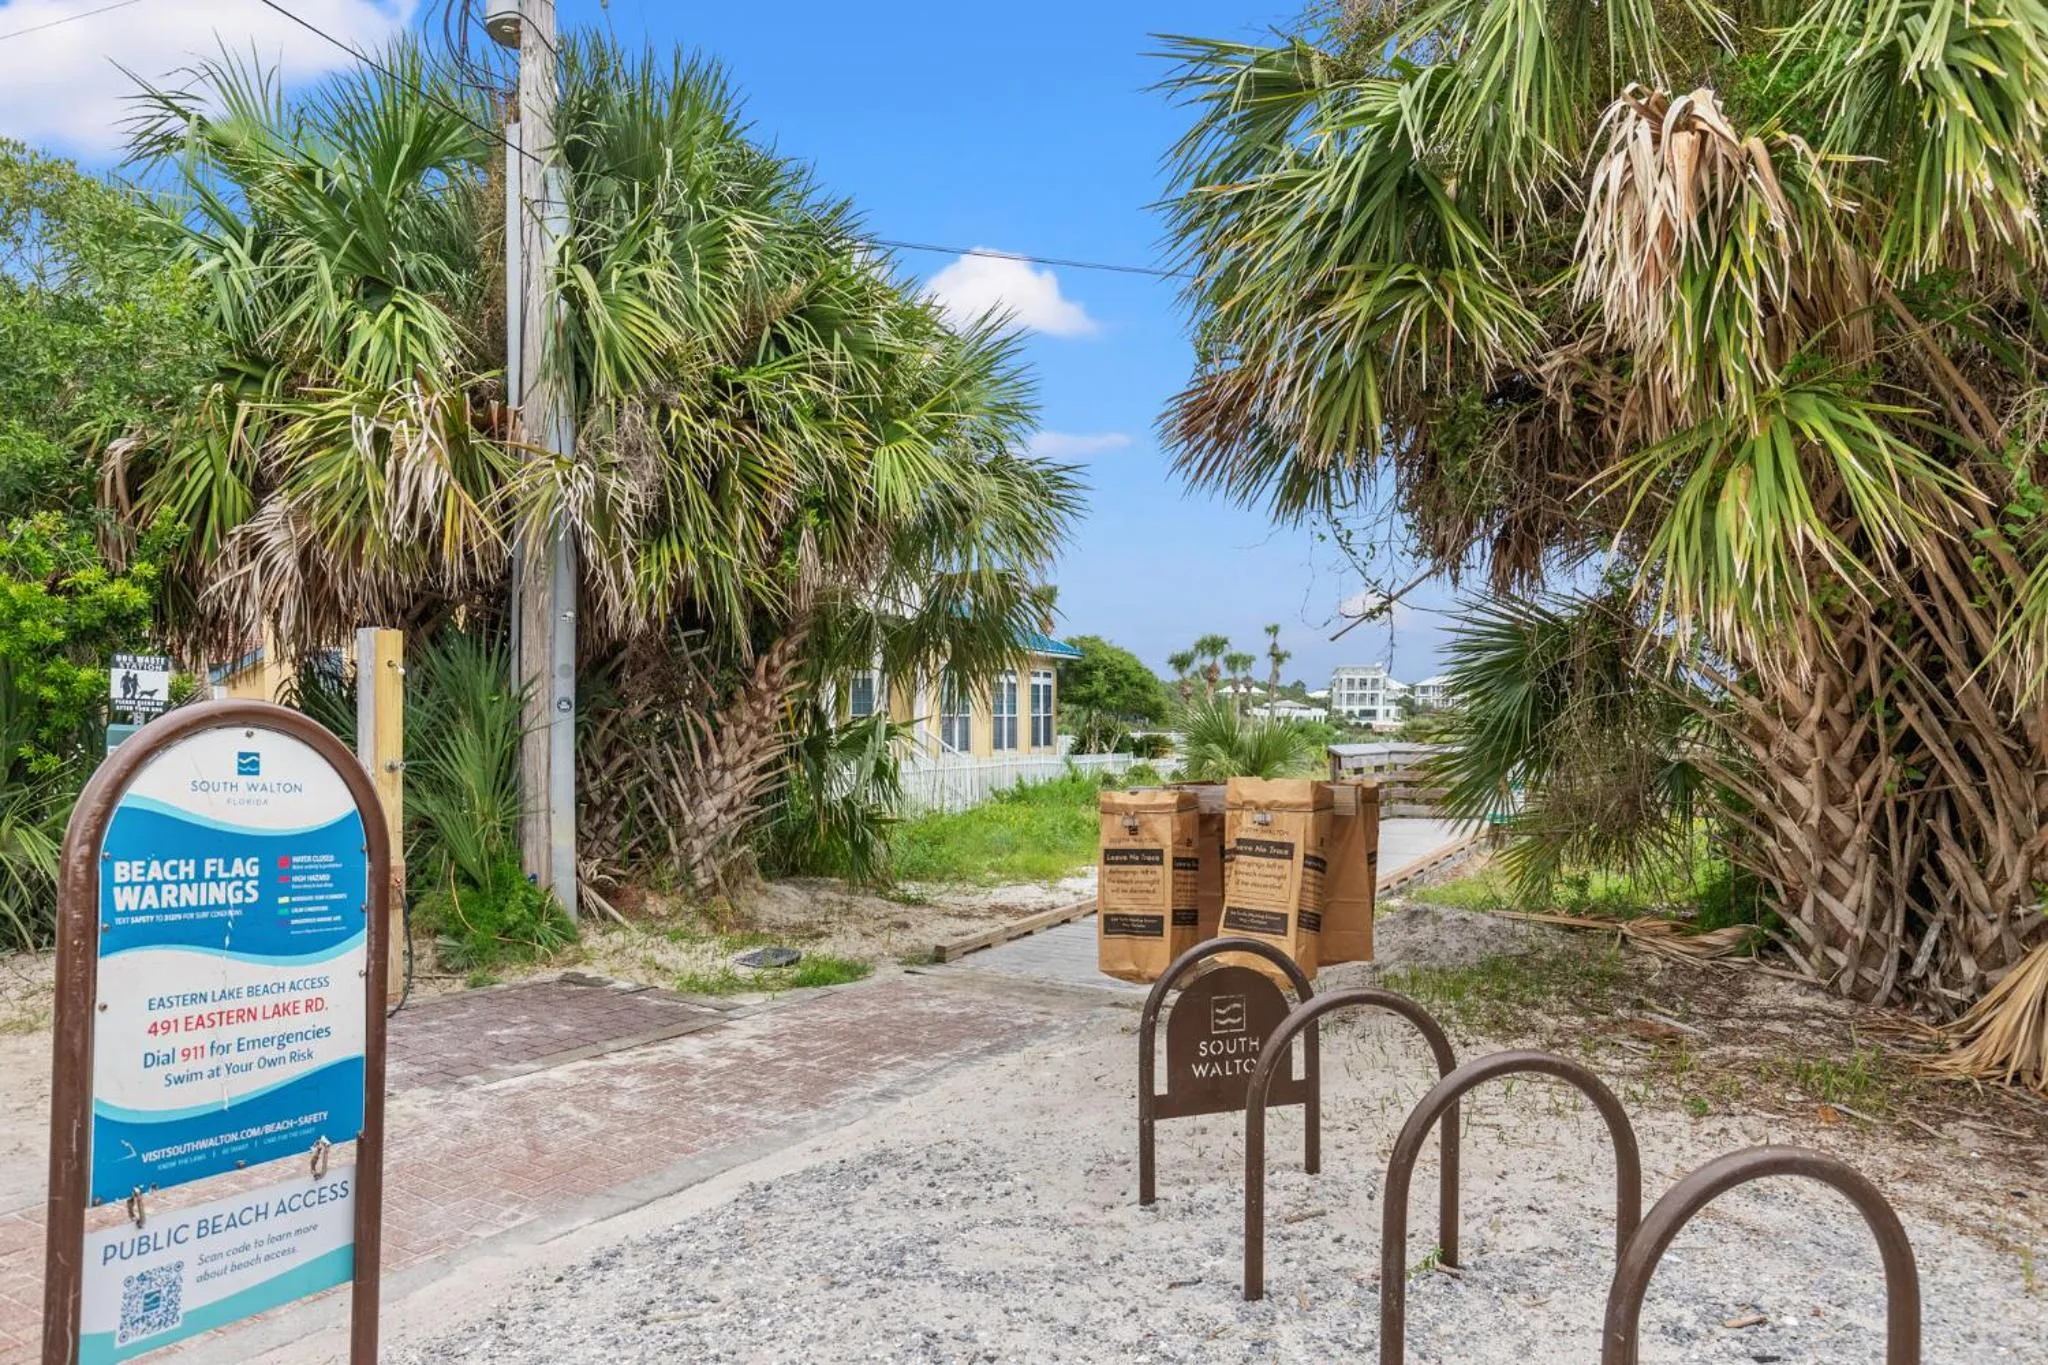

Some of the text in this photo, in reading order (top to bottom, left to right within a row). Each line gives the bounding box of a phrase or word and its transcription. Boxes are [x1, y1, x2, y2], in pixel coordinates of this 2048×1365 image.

[120, 662, 163, 671] STATION
[136, 656, 165, 665] WASTE
[190, 780, 303, 794] SOUTH WALTON
[226, 798, 269, 806] FLORIDA
[1129, 853, 1140, 861] No
[1141, 853, 1160, 862] Trace
[1255, 845, 1267, 853] No
[1269, 845, 1289, 856] Trace
[114, 857, 259, 883] BEACH FLAG
[113, 880, 259, 912] WARNINGS
[147, 976, 330, 1011] EASTERN LAKE BEACH ACCESS
[147, 997, 329, 1037] 491 EASTERN LAKE RD.
[143, 1024, 332, 1069] Dial 911 for Emergencies
[1199, 1036, 1260, 1057] SOUTH
[164, 1048, 314, 1088] Swim at Your Own Risk
[1191, 1058, 1257, 1078] WALTO
[141, 1110, 329, 1164] VISITSOUTHWALTON.COM/BEACH-SAFETY
[102, 1180, 350, 1267] PUBLIC BEACH ACCESS
[197, 1223, 319, 1266] Scan code to learn more
[195, 1264, 228, 1283] about
[230, 1254, 262, 1273] beach
